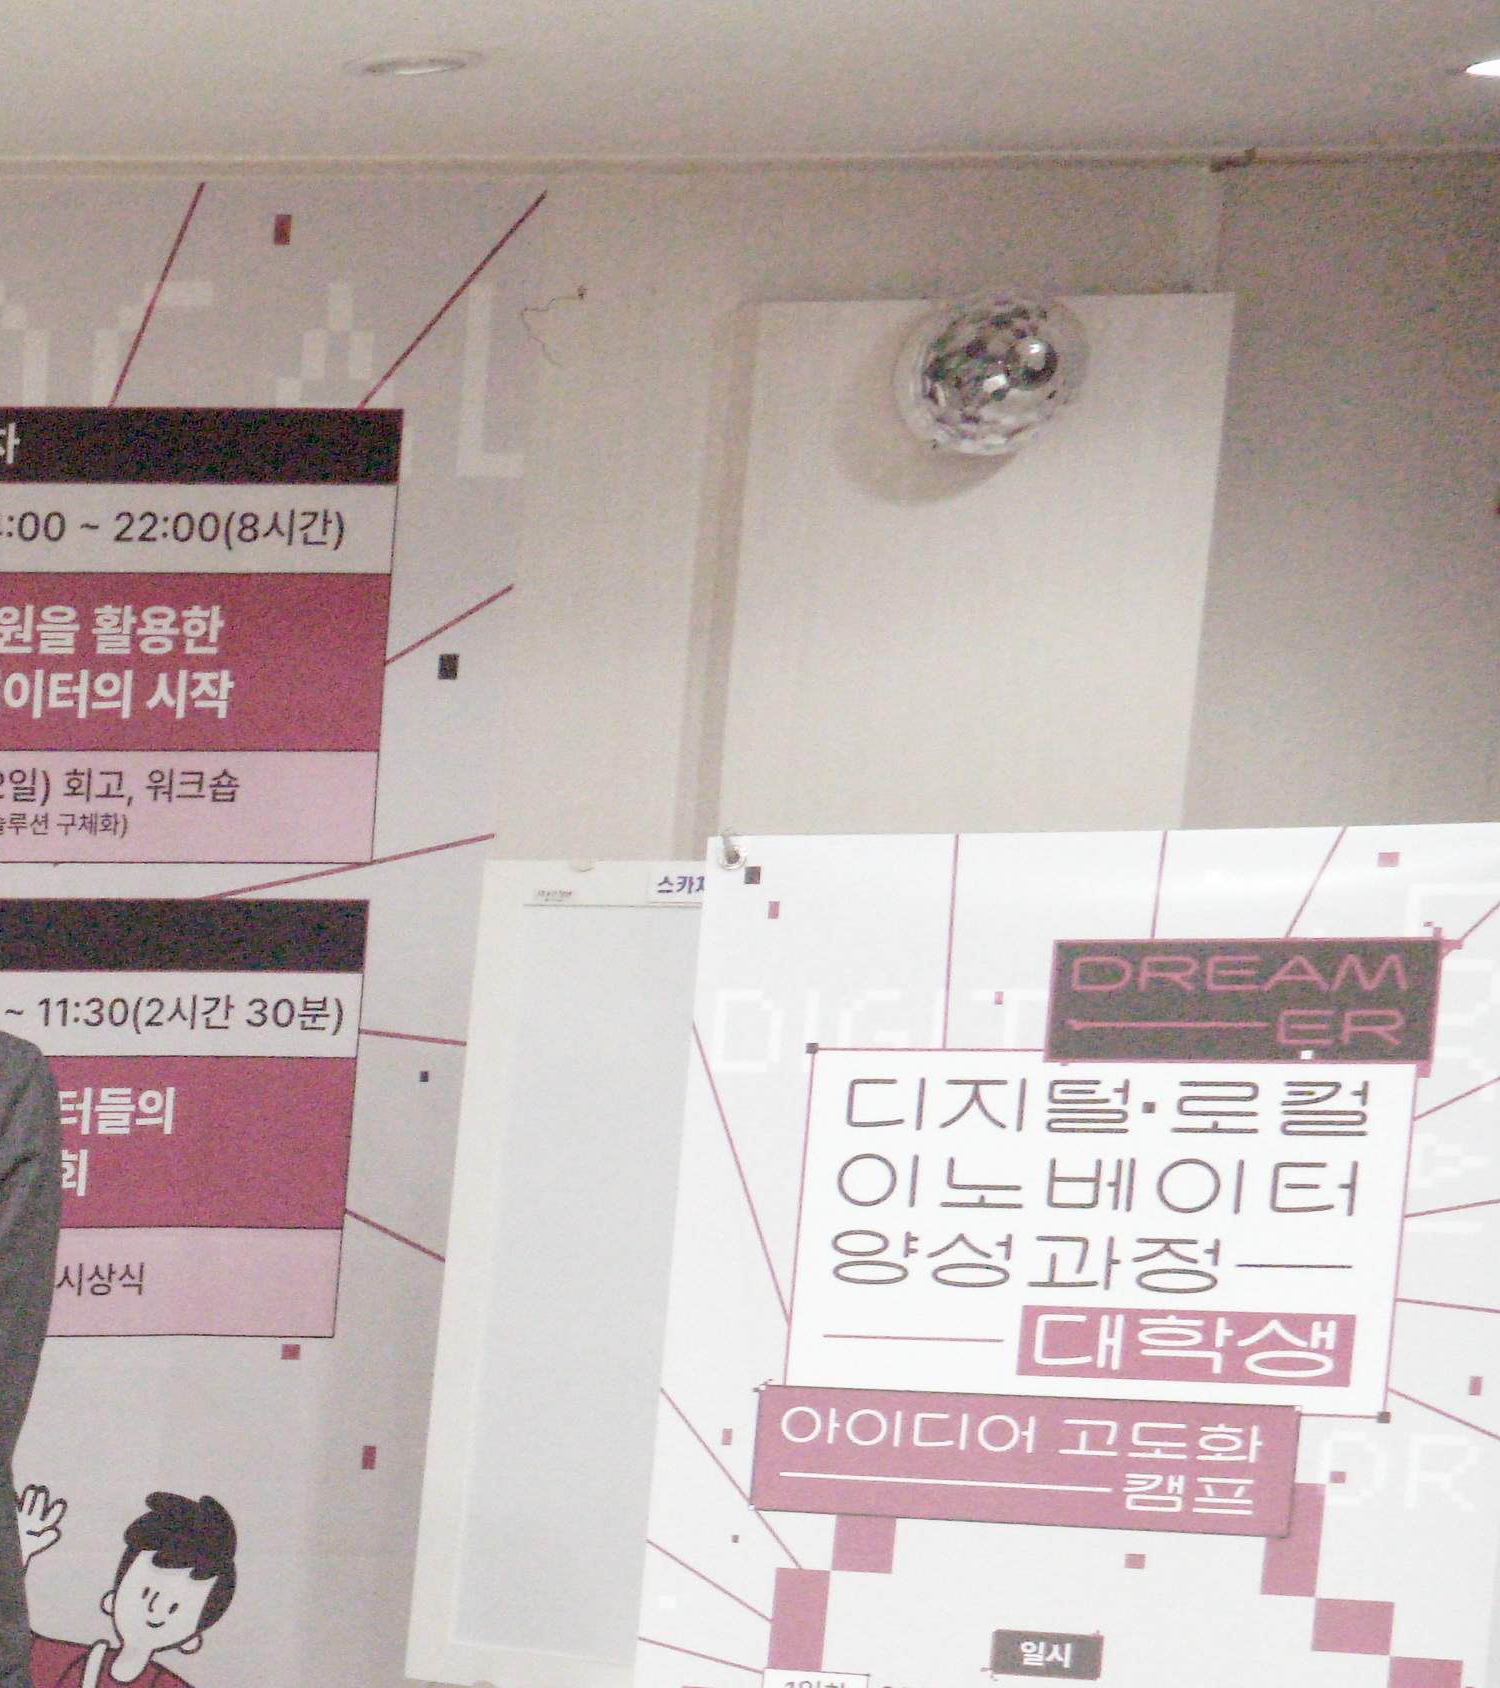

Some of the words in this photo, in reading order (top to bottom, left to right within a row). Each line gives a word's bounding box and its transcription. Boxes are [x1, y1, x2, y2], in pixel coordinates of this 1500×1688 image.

[113, 509, 345, 550] 22:00(8시간)
[92, 605, 225, 654] 활용한
[147, 671, 233, 718] 시작
[63, 769, 133, 806] 회고,
[145, 767, 239, 804] 워크숍
[57, 813, 128, 838] 구체화)
[1069, 953, 1409, 992] DREAM
[38, 997, 235, 1034] 11:30(2시간
[247, 995, 344, 1034] 30분)
[1276, 1009, 1405, 1046] ER
[836, 1153, 1359, 1216] 이노베이터
[57, 1261, 145, 1296] 시상식
[831, 1229, 1222, 1294] 양성과정
[1032, 1313, 1336, 1379] 대학생
[780, 1406, 1036, 1453] 아이디어
[1058, 1418, 1263, 1464] 고도화
[1122, 1471, 1254, 1516] 캠프
[1020, 1640, 1072, 1669] 일시
